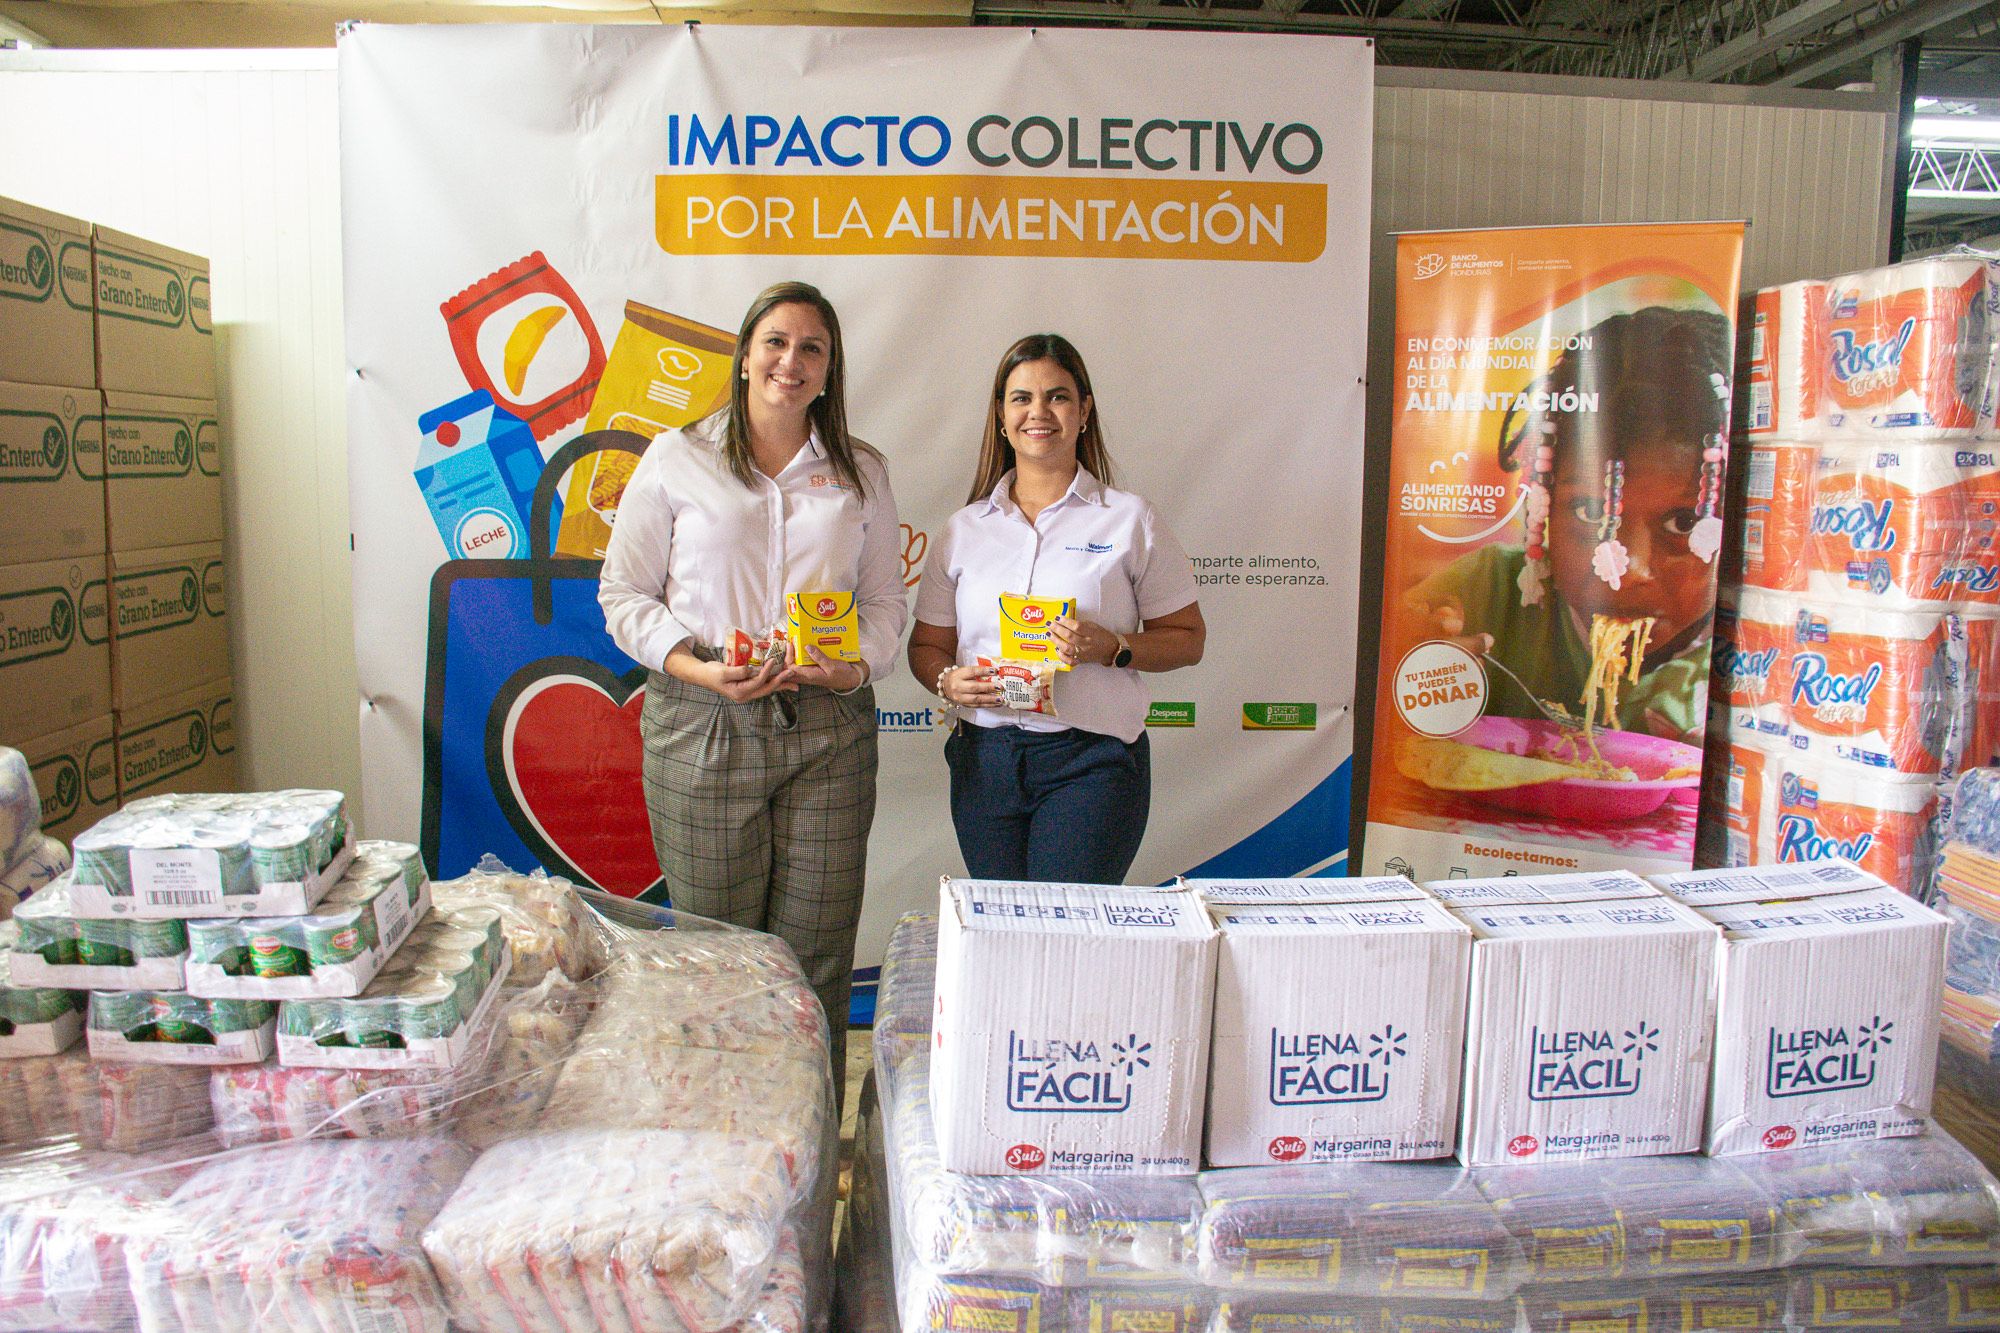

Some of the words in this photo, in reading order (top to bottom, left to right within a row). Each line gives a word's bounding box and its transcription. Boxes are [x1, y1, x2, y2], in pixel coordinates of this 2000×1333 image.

[668, 114, 952, 167] IMPACTO
[966, 115, 1324, 175] COLECTIVO
[686, 195, 795, 240] POR
[812, 197, 873, 240] LA
[883, 191, 1284, 247] ALIMENTACIÓN
[120, 269, 133, 281] con
[99, 280, 133, 305] Grano
[135, 288, 168, 315] Entero
[1408, 338, 1428, 353] EN
[1432, 334, 1593, 353] CONMEMORACIÓN
[1831, 317, 1916, 382] Rosal
[1407, 357, 1426, 371] AL
[1430, 352, 1456, 370] DÍA
[1461, 355, 1538, 371] MUNDIAL
[1407, 375, 1425, 389] DE
[1430, 375, 1448, 389] LA
[1405, 386, 1599, 413] ALIMENTACIÓN
[126, 429, 140, 439] con
[0, 444, 44, 468] Entero
[108, 445, 141, 466] Grano
[143, 446, 176, 466] Entero
[1978, 454, 1995, 466] 18
[1401, 483, 1505, 498] ALIMENTANDO
[1401, 496, 1496, 514] SONRISAS
[1812, 501, 1896, 551] Rosal
[465, 526, 507, 551] LECHE
[1248, 555, 1320, 570] alimento,
[1245, 575, 1329, 588] esperanza.
[1932, 566, 1999, 592] Rosal
[118, 605, 149, 626] Grano
[151, 599, 184, 619] Entero
[818, 601, 835, 614] Suli
[1022, 608, 1045, 621] Suli
[8, 627, 52, 650] Entero
[811, 625, 847, 635] Margarina
[839, 649, 845, 657] 5
[1405, 673, 1418, 682] TU
[1419, 663, 1467, 680] TAMBIÉN
[1791, 653, 1883, 707] Rosal
[1006, 680, 1024, 693] ARROZ
[1418, 676, 1457, 690] PUEDES
[1403, 682, 1480, 711] DONAR
[1152, 709, 1188, 719] Despensa
[124, 760, 157, 783] Grano
[158, 744, 192, 768] Entero
[1463, 843, 1579, 869] Recolectamos:
[1109, 905, 1153, 914] LLENA
[1112, 911, 1171, 925] FÁCIL
[1606, 907, 1647, 916] LLENA
[1832, 906, 1874, 916] LLENA
[1280, 1033, 1360, 1057] LLENA
[1540, 1030, 1614, 1054] LLENA
[1777, 1027, 1849, 1053] LLENA
[1018, 1039, 1101, 1062] LLENA
[1279, 1056, 1380, 1096] FÁCIL
[1537, 1053, 1632, 1092] FÁCIL
[1775, 1051, 1866, 1089] FÁCIL
[1017, 1062, 1122, 1103] FÁCIL
[1805, 1119, 1876, 1137] Margarina
[1314, 1137, 1391, 1152] Margarina
[1509, 1139, 1537, 1154] Suli
[1545, 1132, 1620, 1147] Margarina
[1765, 1129, 1796, 1146] Suli
[1271, 1139, 1305, 1155] Suli
[1007, 1148, 1044, 1165] Suli
[1052, 1150, 1134, 1165] Margarina
